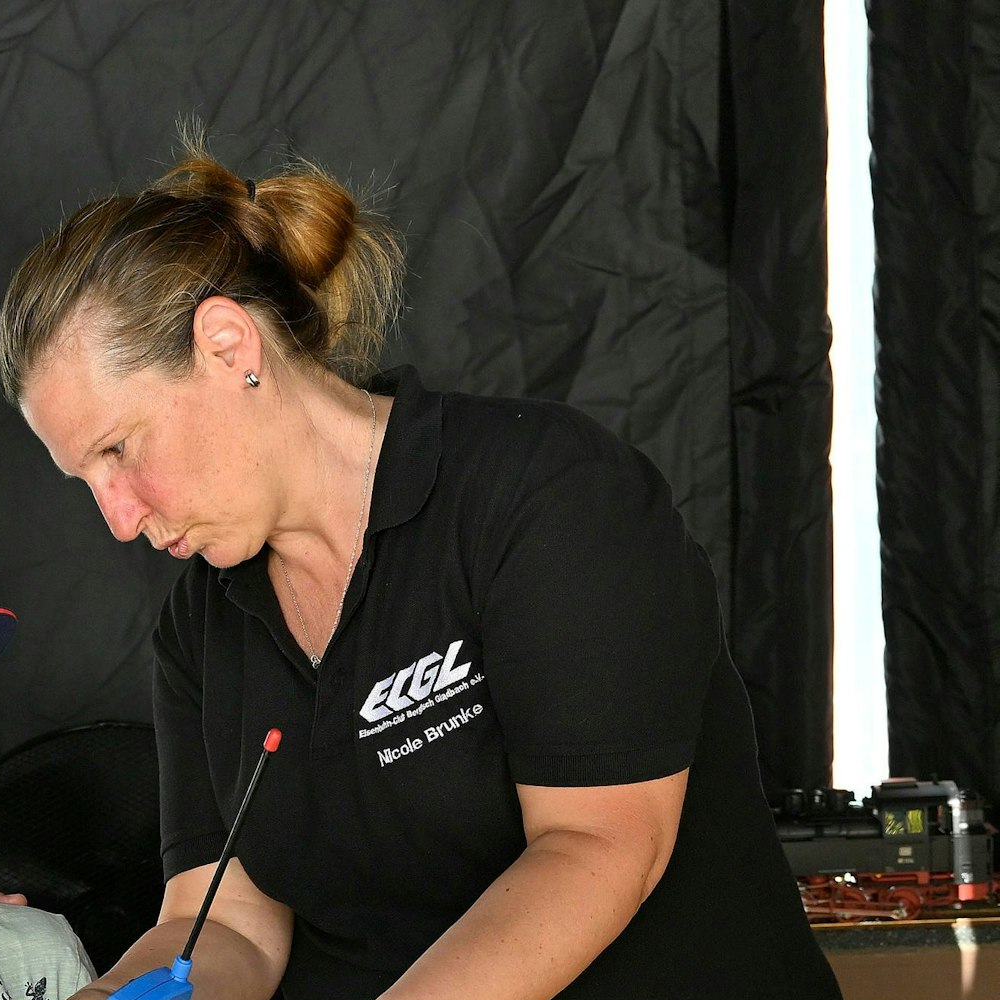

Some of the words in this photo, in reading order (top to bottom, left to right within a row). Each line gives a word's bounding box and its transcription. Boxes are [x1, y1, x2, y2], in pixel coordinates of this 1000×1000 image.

[359, 639, 472, 723] ECGL
[377, 737, 423, 768] Nicole
[423, 703, 484, 743] Brunke
